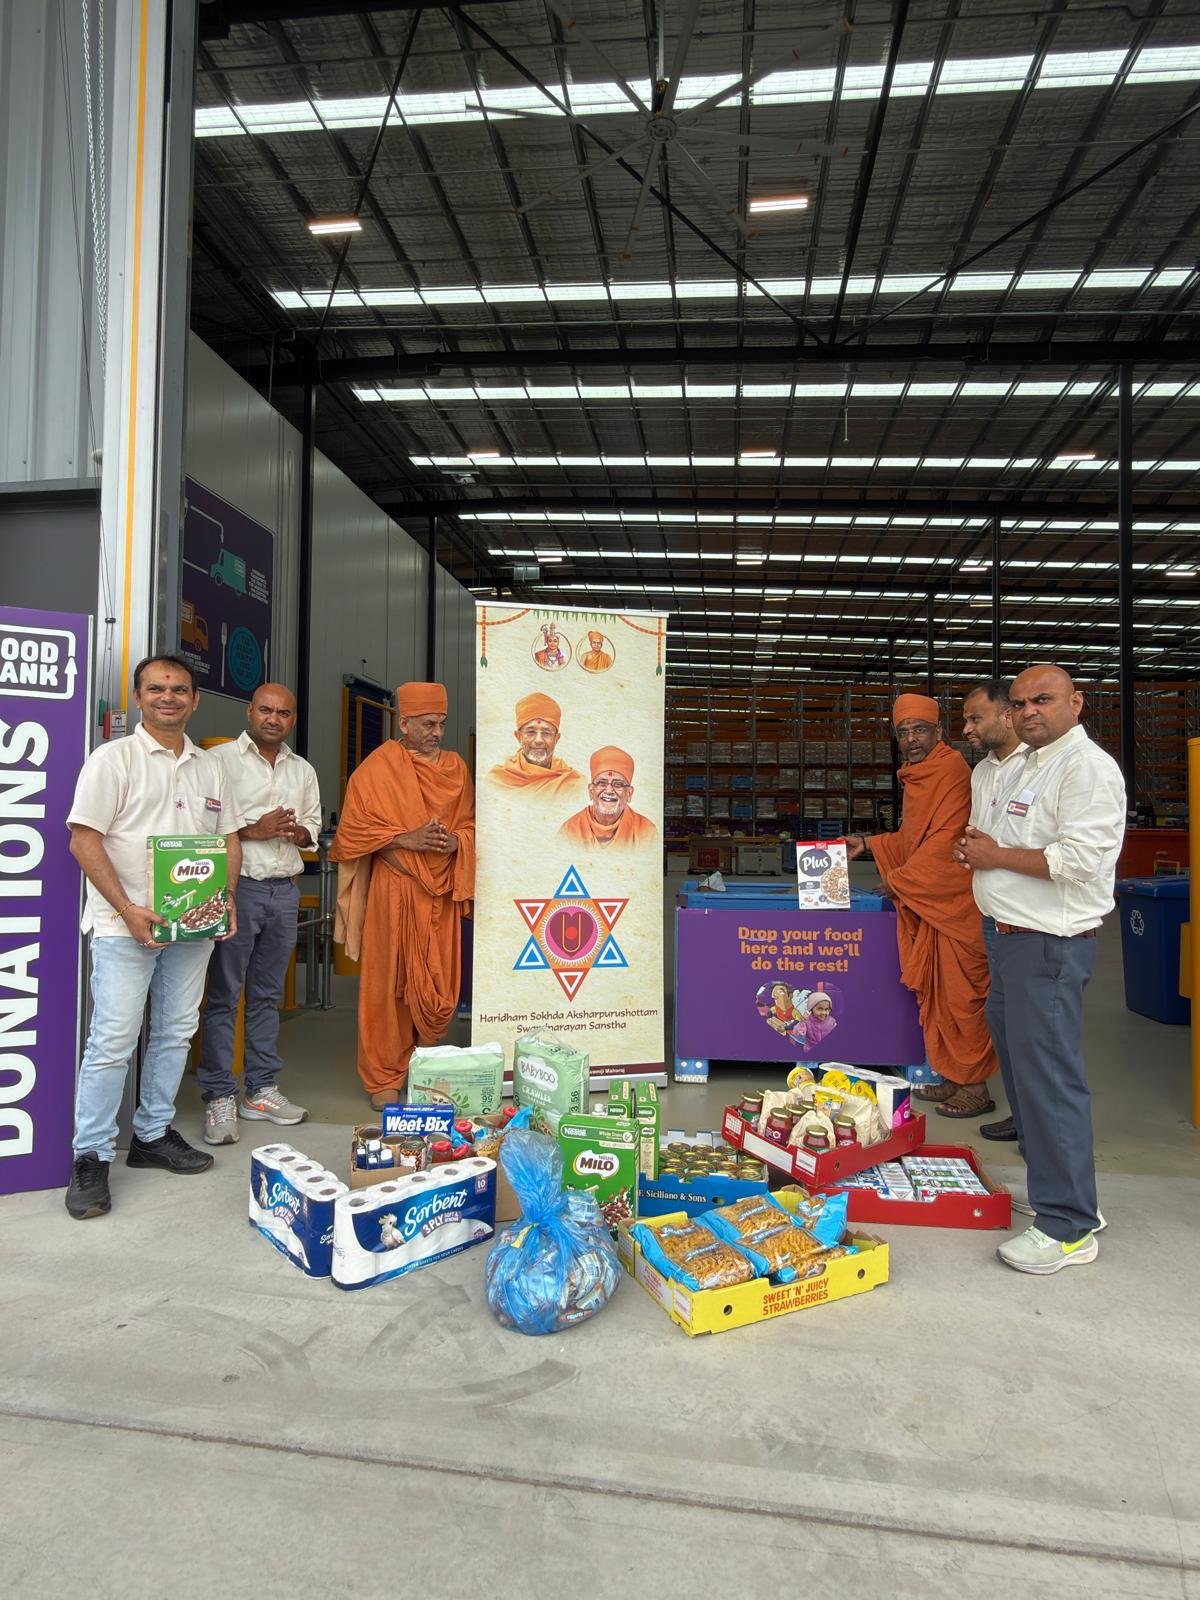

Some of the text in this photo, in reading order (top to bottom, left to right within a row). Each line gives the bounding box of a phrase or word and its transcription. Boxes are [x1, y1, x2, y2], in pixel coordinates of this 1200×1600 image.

[0, 637, 59, 664] OOD
[0, 661, 59, 687] ANK
[177, 865, 210, 876] MILO
[801, 856, 829, 871] Plus
[738, 926, 863, 943] Drop your food
[740, 940, 860, 957] here and we'll
[751, 956, 849, 972] do the rest!
[480, 1008, 658, 1023] Haridham Sokhda Aksharpurushottam
[516, 1020, 627, 1034] Swnarayan Sanstha
[386, 1116, 452, 1132] Weet-Bix
[580, 1157, 615, 1171] MILO
[477, 1180, 486, 1189] 10
[645, 1189, 678, 1200] Siciliano
[679, 1192, 686, 1201] &
[688, 1193, 707, 1203] Sons
[404, 1188, 468, 1237] Sorbent
[763, 1288, 791, 1304] SWEET
[805, 1278, 829, 1293] JUICY
[762, 1289, 829, 1316] STRAWBERRIES
